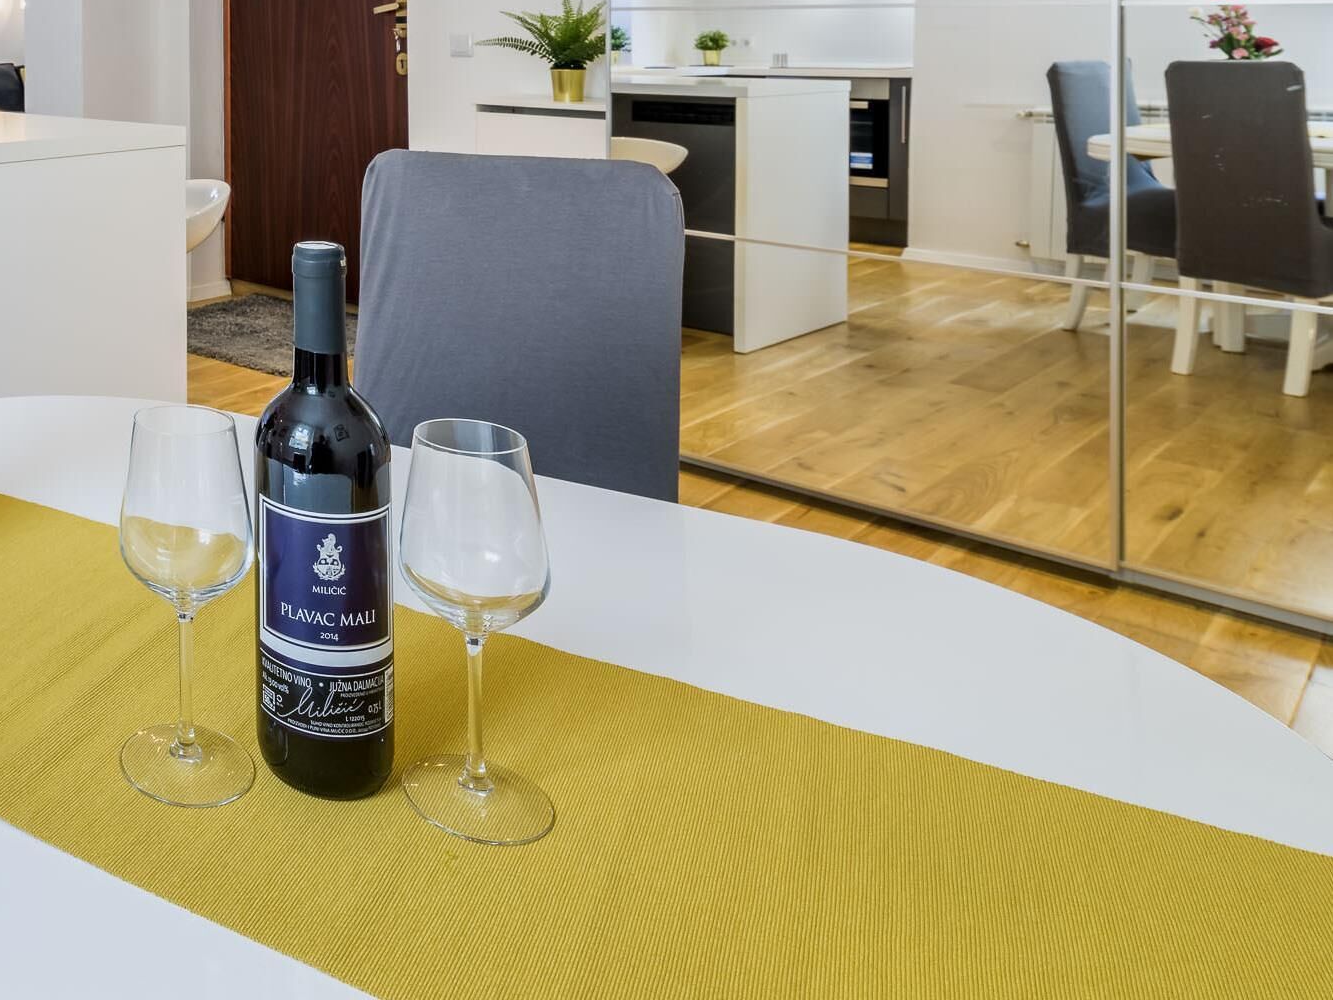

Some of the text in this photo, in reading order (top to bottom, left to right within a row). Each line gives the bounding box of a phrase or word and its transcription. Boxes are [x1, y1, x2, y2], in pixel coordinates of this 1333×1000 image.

[312, 585, 347, 595] MILIČIĆ
[281, 602, 376, 626] PLAVAC MALI
[320, 632, 339, 641] 2014
[293, 674, 312, 688] VINO
[329, 679, 352, 692] JUŽNA
